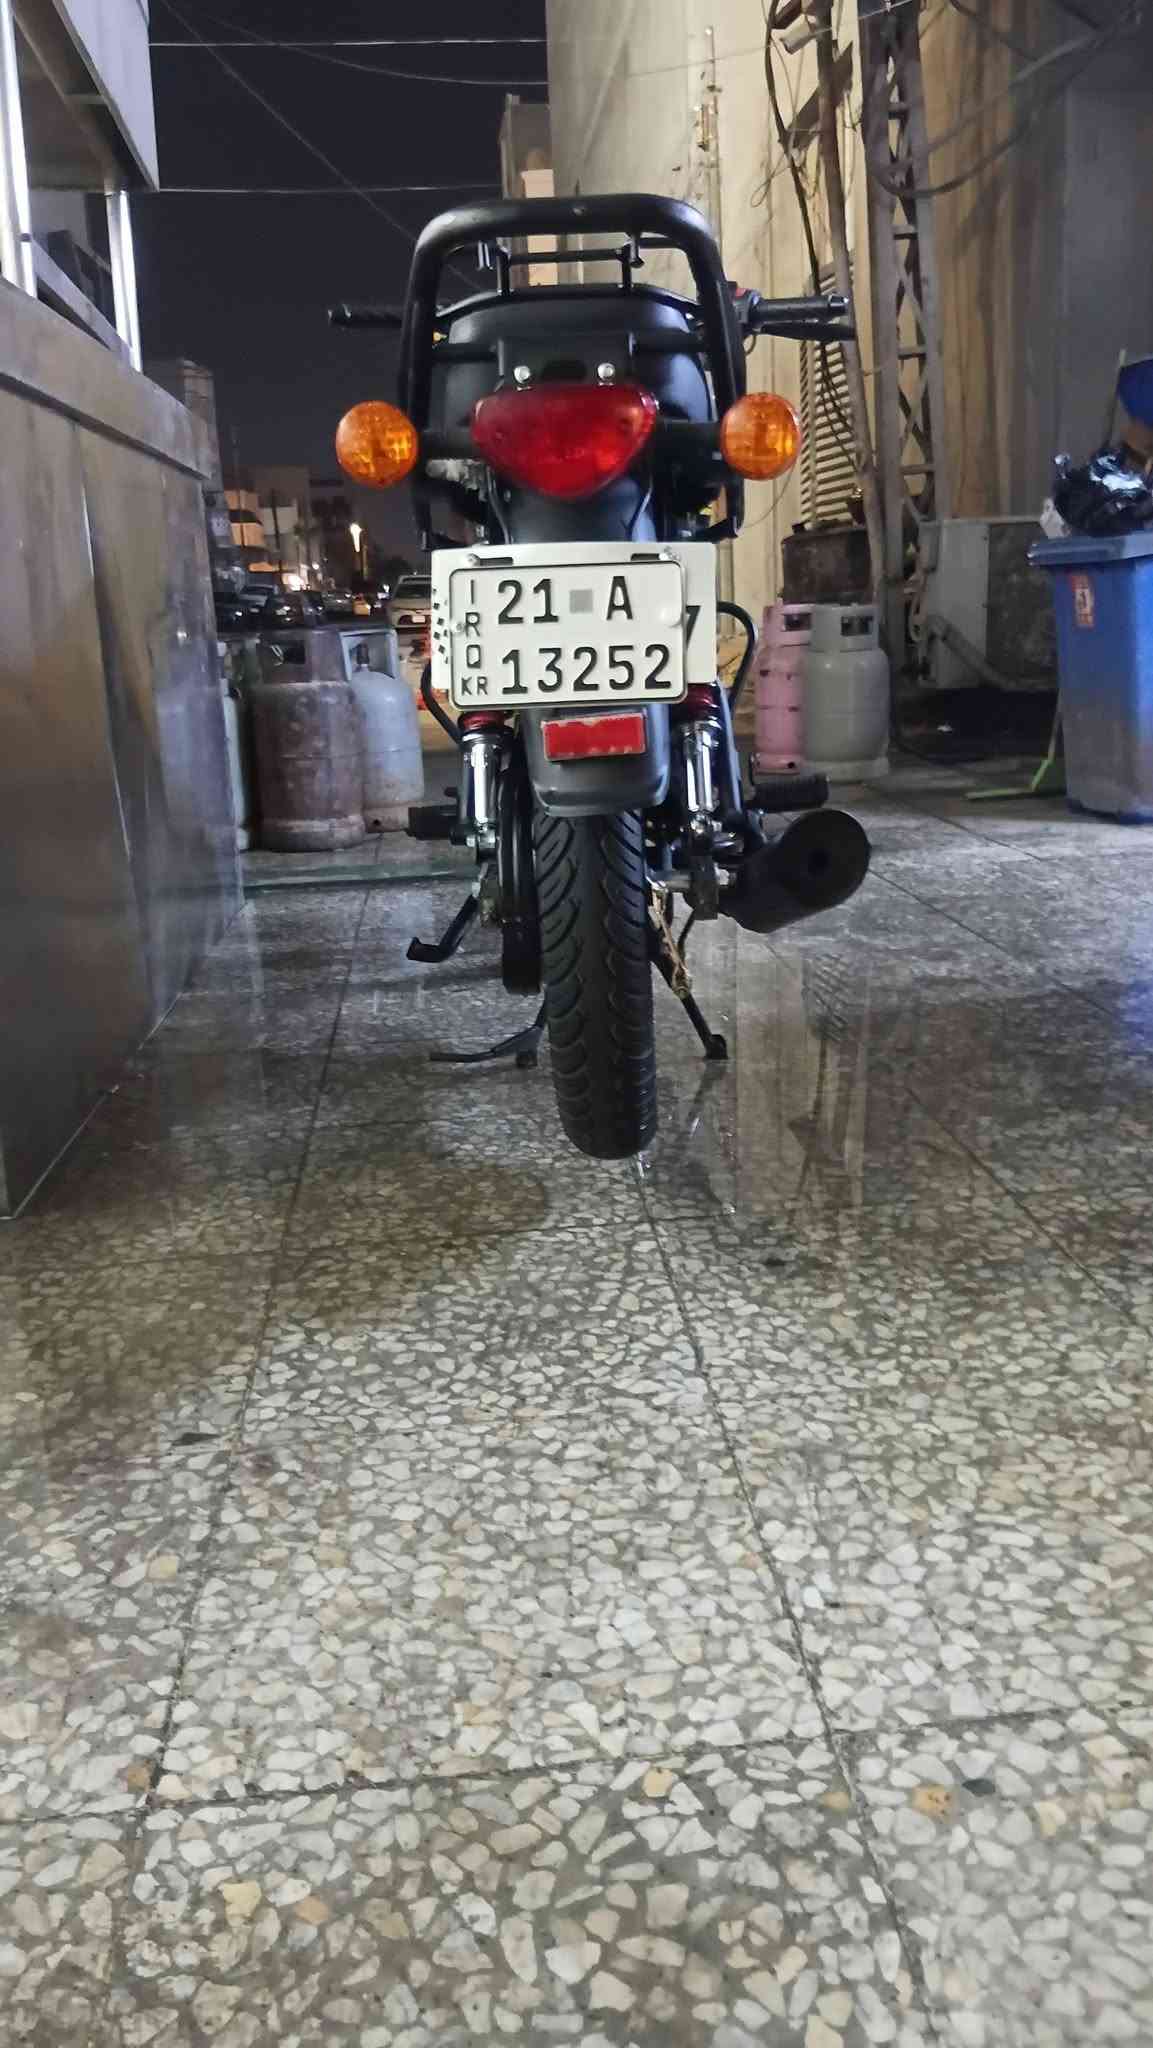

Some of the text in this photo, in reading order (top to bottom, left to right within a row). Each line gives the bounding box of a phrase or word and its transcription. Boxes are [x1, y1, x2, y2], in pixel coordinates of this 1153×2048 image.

[497, 575, 634, 625] 21 A
[460, 674, 489, 696] KR
[501, 643, 672, 695] 13252
